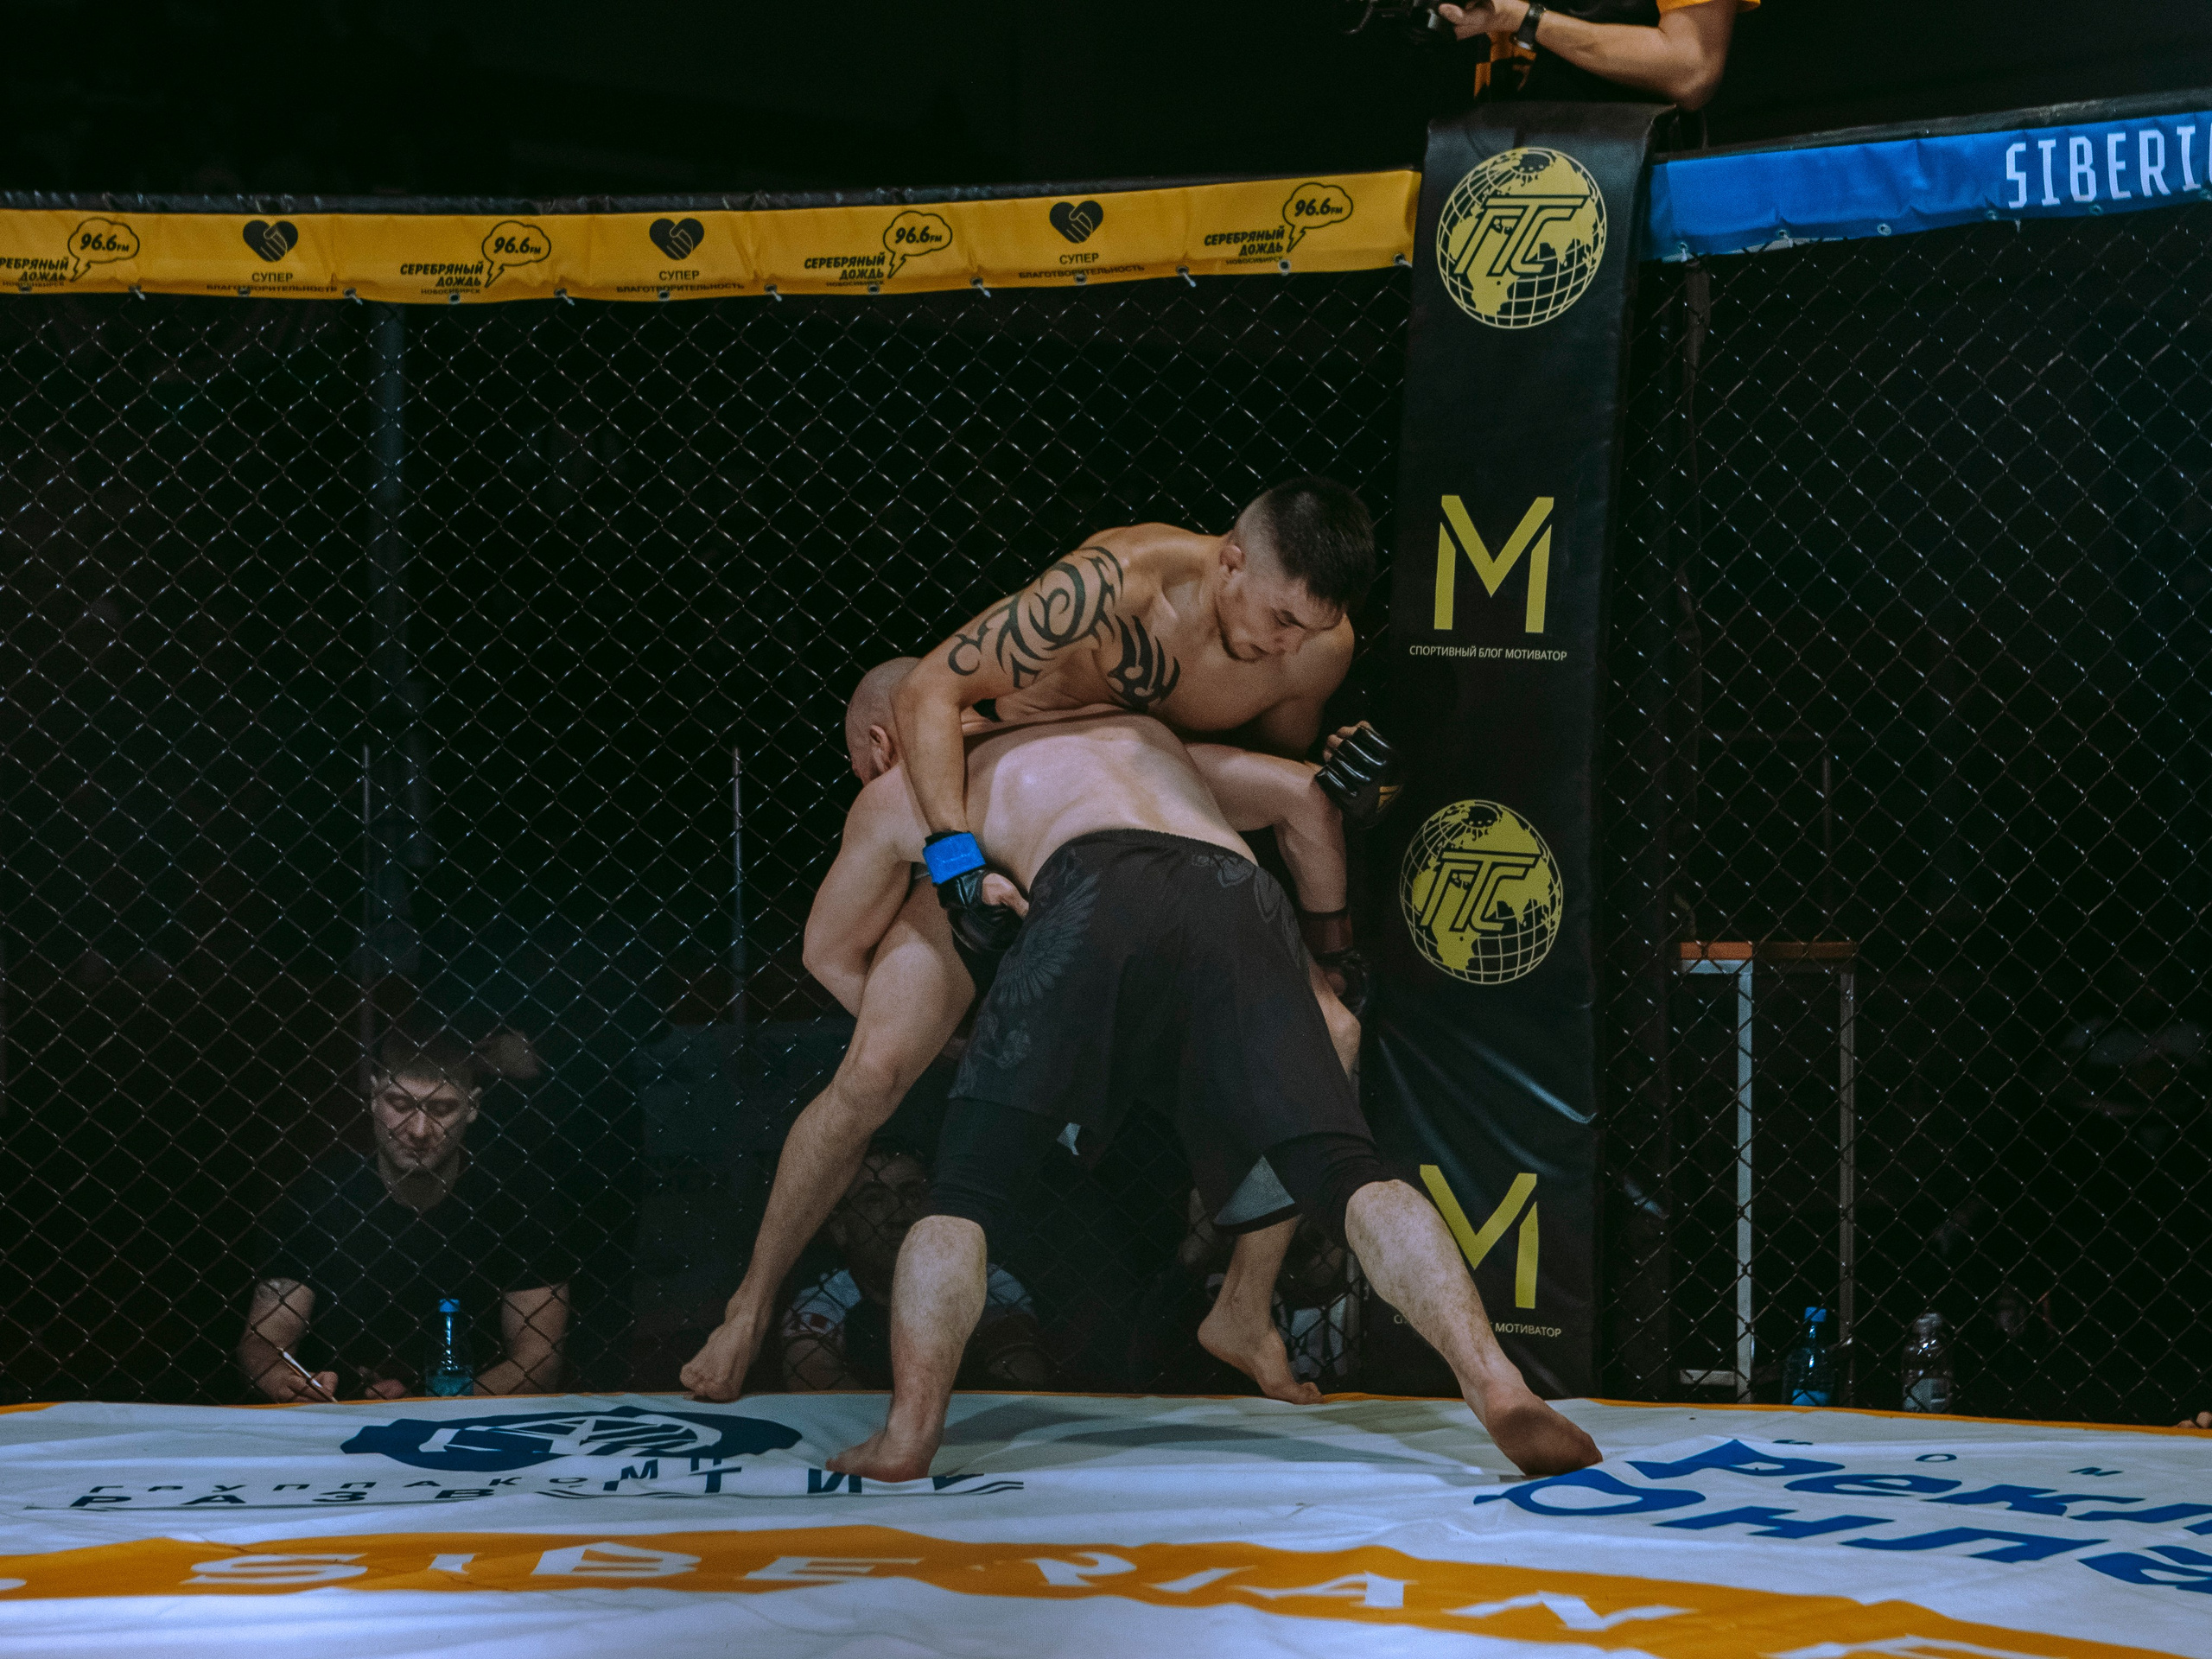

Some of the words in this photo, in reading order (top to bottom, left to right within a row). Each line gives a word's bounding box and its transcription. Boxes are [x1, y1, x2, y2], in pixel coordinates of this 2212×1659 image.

[2005, 123, 2212, 209] SIBERI
[1204, 226, 1286, 246] СЕРЕБРЯНЫЙ
[1238, 242, 1284, 257] ДОЖДЬ
[804, 251, 886, 269] СЕРЕБРЯНЫЙ
[1059, 252, 1099, 264] СУПЕР
[400, 261, 484, 275] СЕРЕБРЯНЫЙ
[839, 268, 884, 281] ДОЖДЬ
[1018, 264, 1145, 279] БЛАГОТВОРИТЕЛЬНОСТЬ
[19, 271, 67, 282] ДОЖДЬ
[251, 272, 294, 283] СУПЕР
[435, 276, 482, 288] ДОЖДЬ
[658, 270, 700, 281] СУПЕР
[616, 283, 745, 293] БЛАГОТВОРИТЕЛЬНОСТЬ
[1409, 645, 1477, 658] СПОРТИВНЫЙ
[1478, 647, 1503, 658] БЛОГ
[1504, 648, 1568, 661] МОТИВАТОР
[1495, 1322, 1562, 1338] МОТИВАТОР
